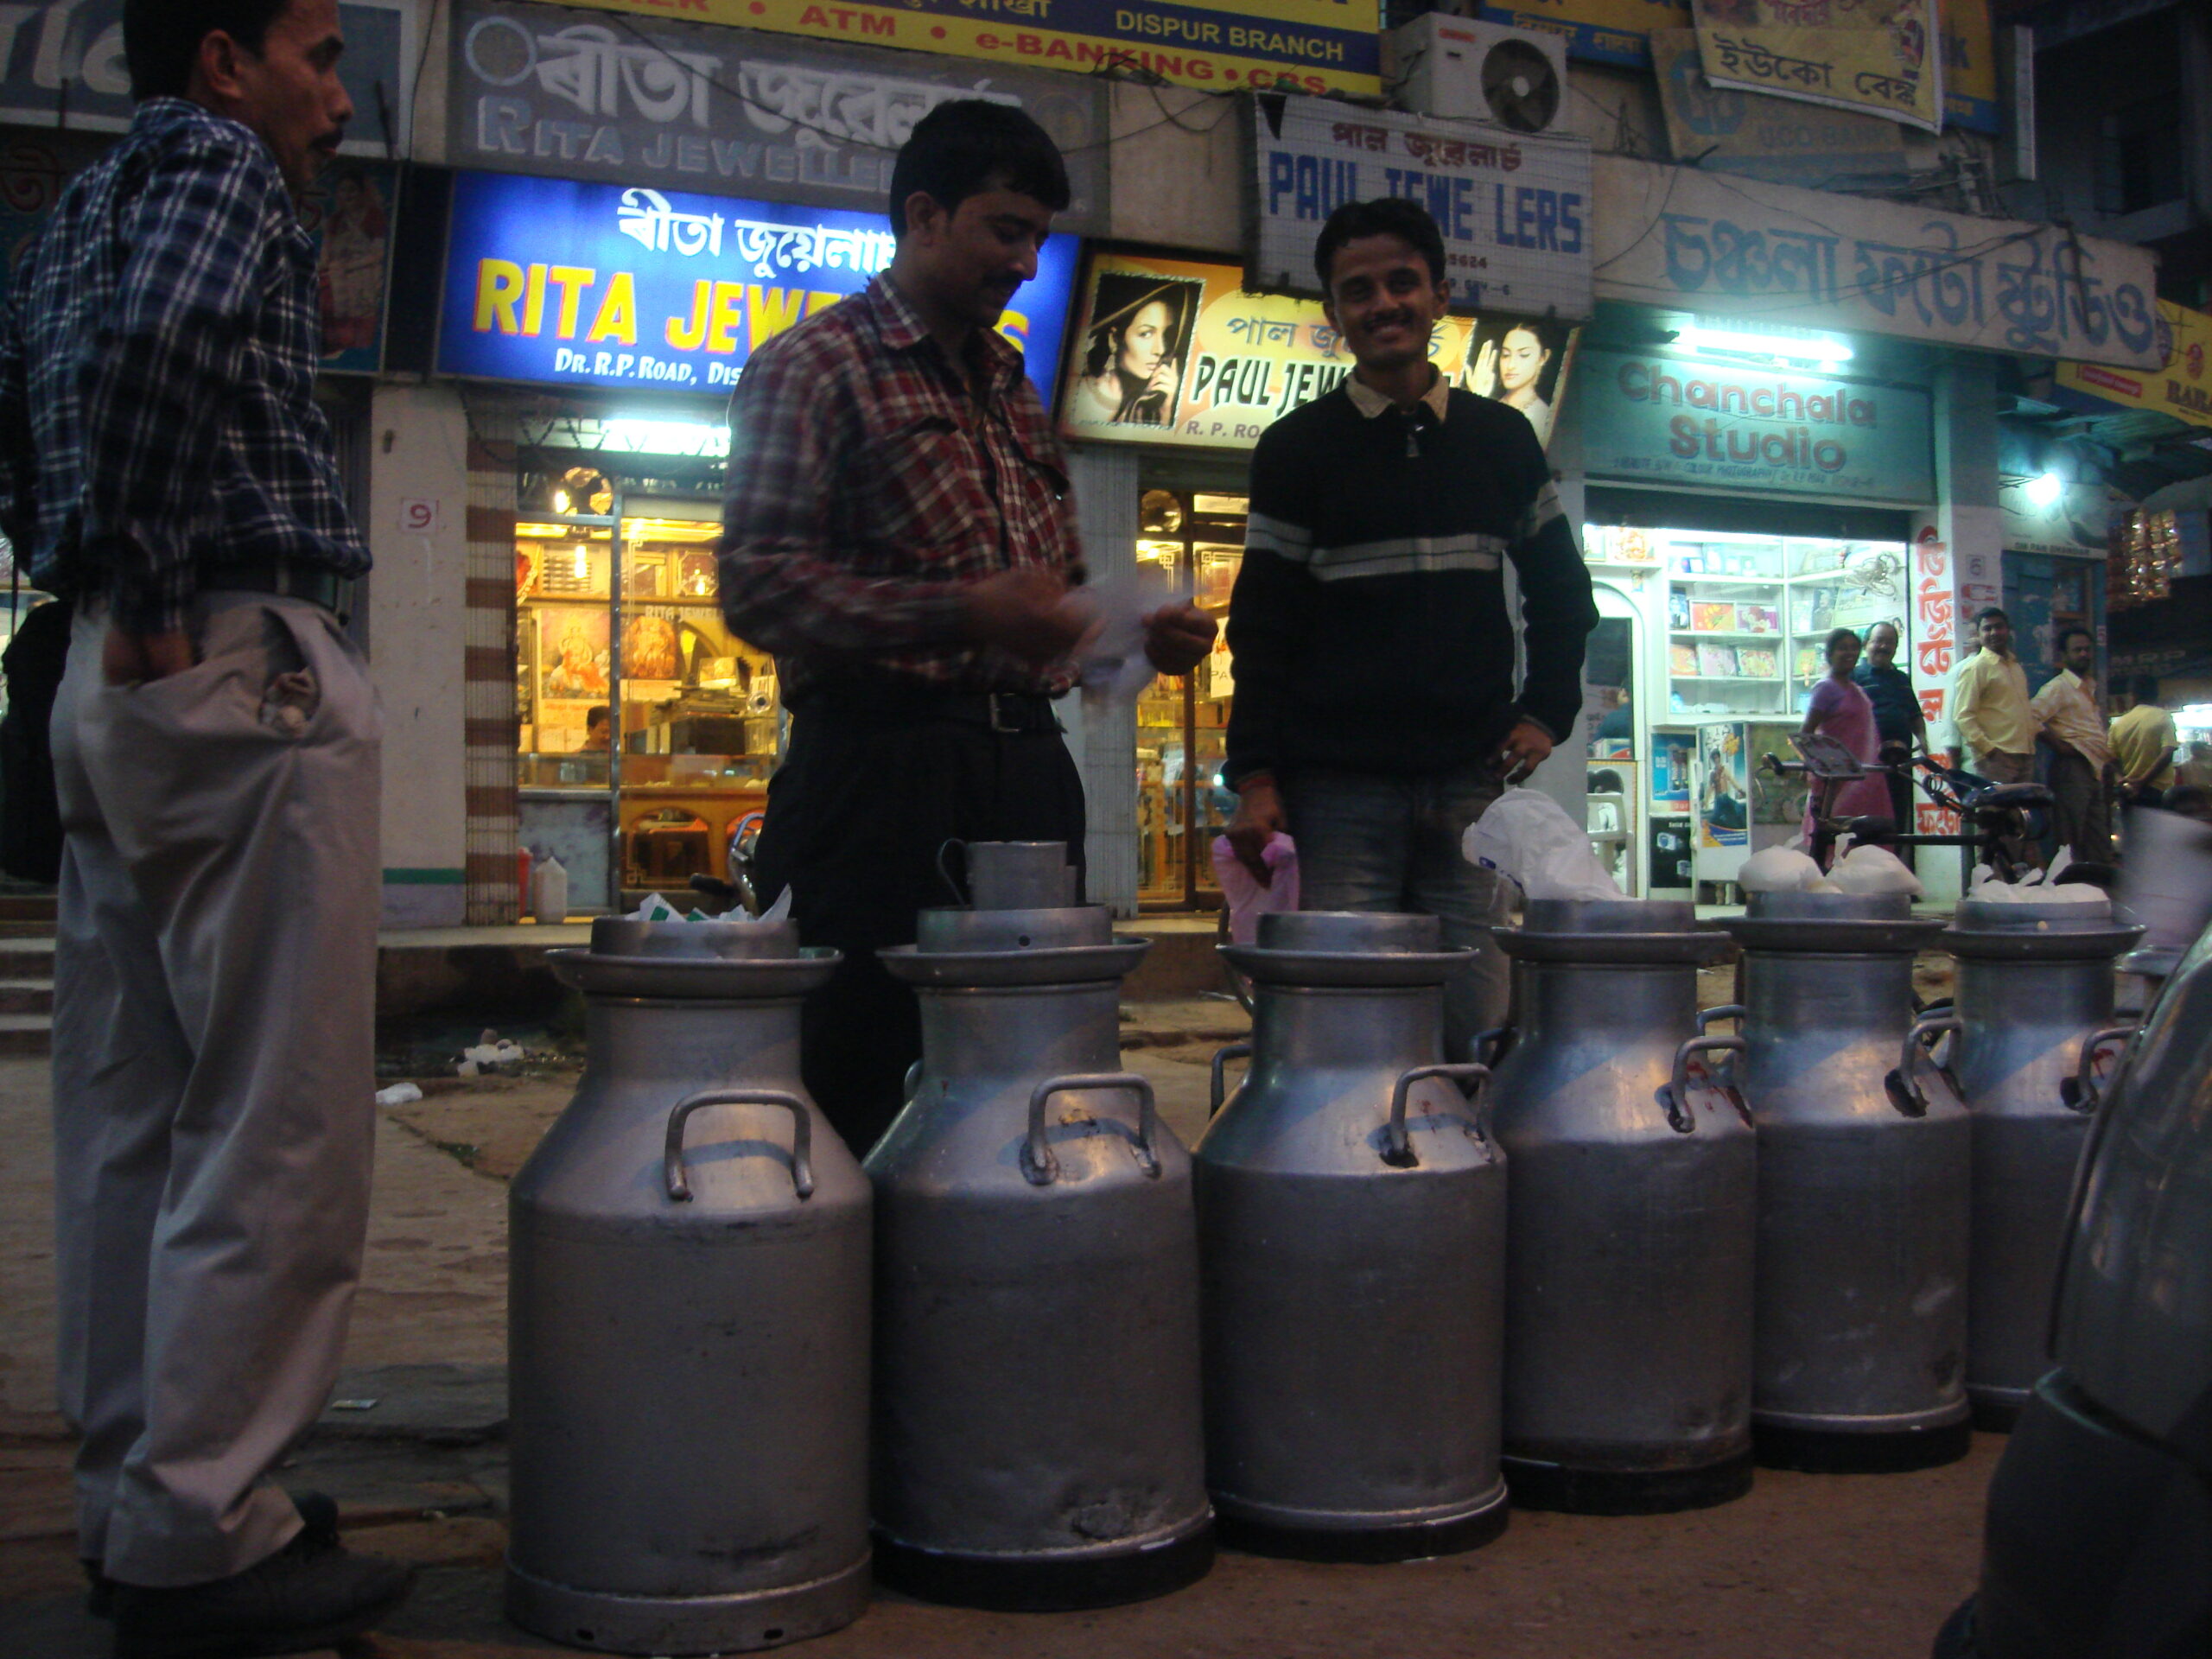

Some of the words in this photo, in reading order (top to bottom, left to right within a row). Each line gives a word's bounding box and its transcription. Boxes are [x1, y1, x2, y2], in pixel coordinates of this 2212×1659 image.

[798, 6, 897, 37] ATM
[1116, 10, 1221, 45] DISPUR
[1229, 26, 1344, 62] BRANCH
[477, 94, 626, 166] RITA
[472, 257, 638, 346] RITA
[1226, 315, 1299, 347] পাল
[707, 361, 744, 385] DIS
[1192, 355, 1272, 408] PAUL
[1616, 360, 1878, 429] Chanchala
[1185, 420, 1204, 435] R.
[1211, 421, 1227, 437] P.
[1234, 423, 1262, 439] RO
[1669, 414, 1847, 474] Studio
[407, 503, 433, 530] 9
